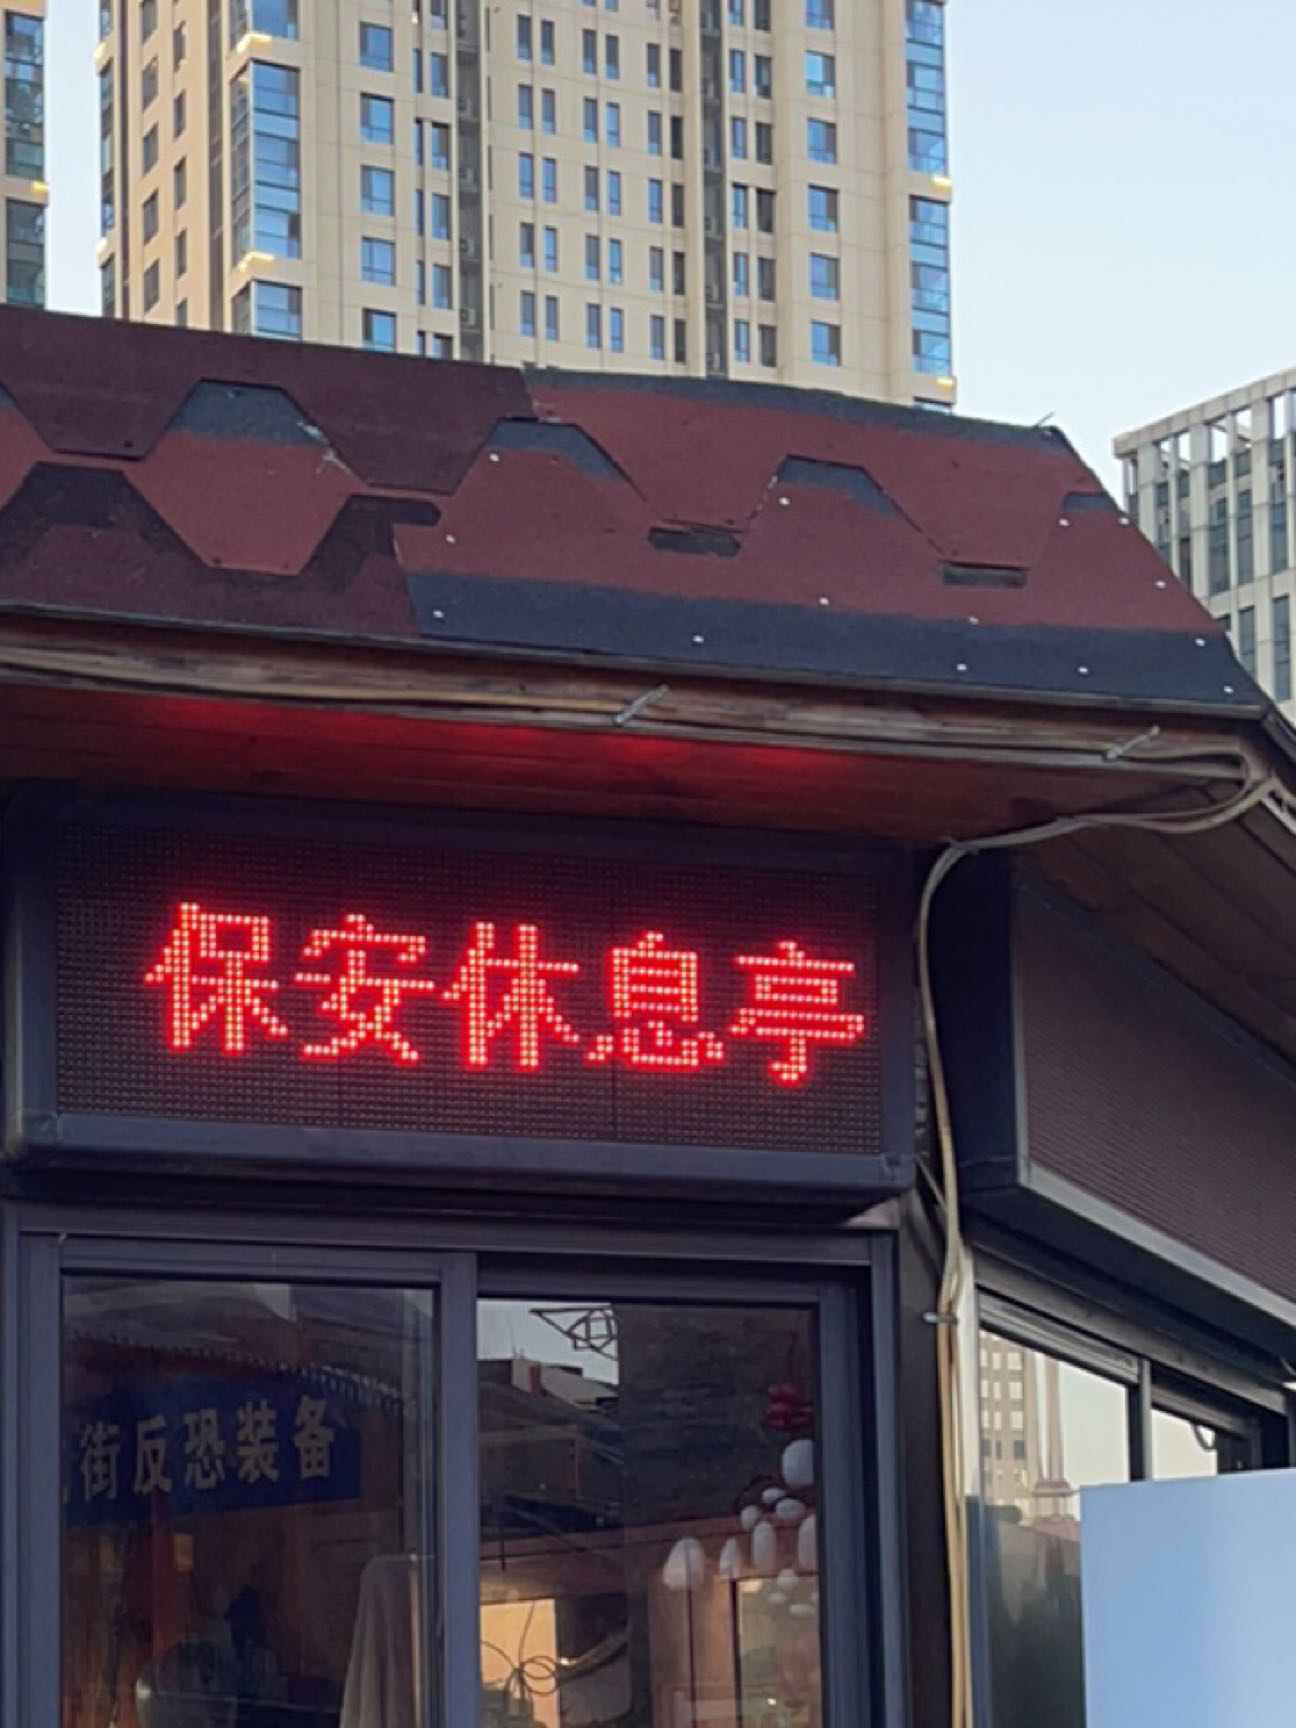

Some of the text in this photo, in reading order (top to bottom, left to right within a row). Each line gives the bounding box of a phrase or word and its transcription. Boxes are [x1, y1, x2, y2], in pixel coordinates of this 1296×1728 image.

[144, 900, 868, 1086] 保安休息亭
[64, 1394, 337, 1503] 街反恐装备
